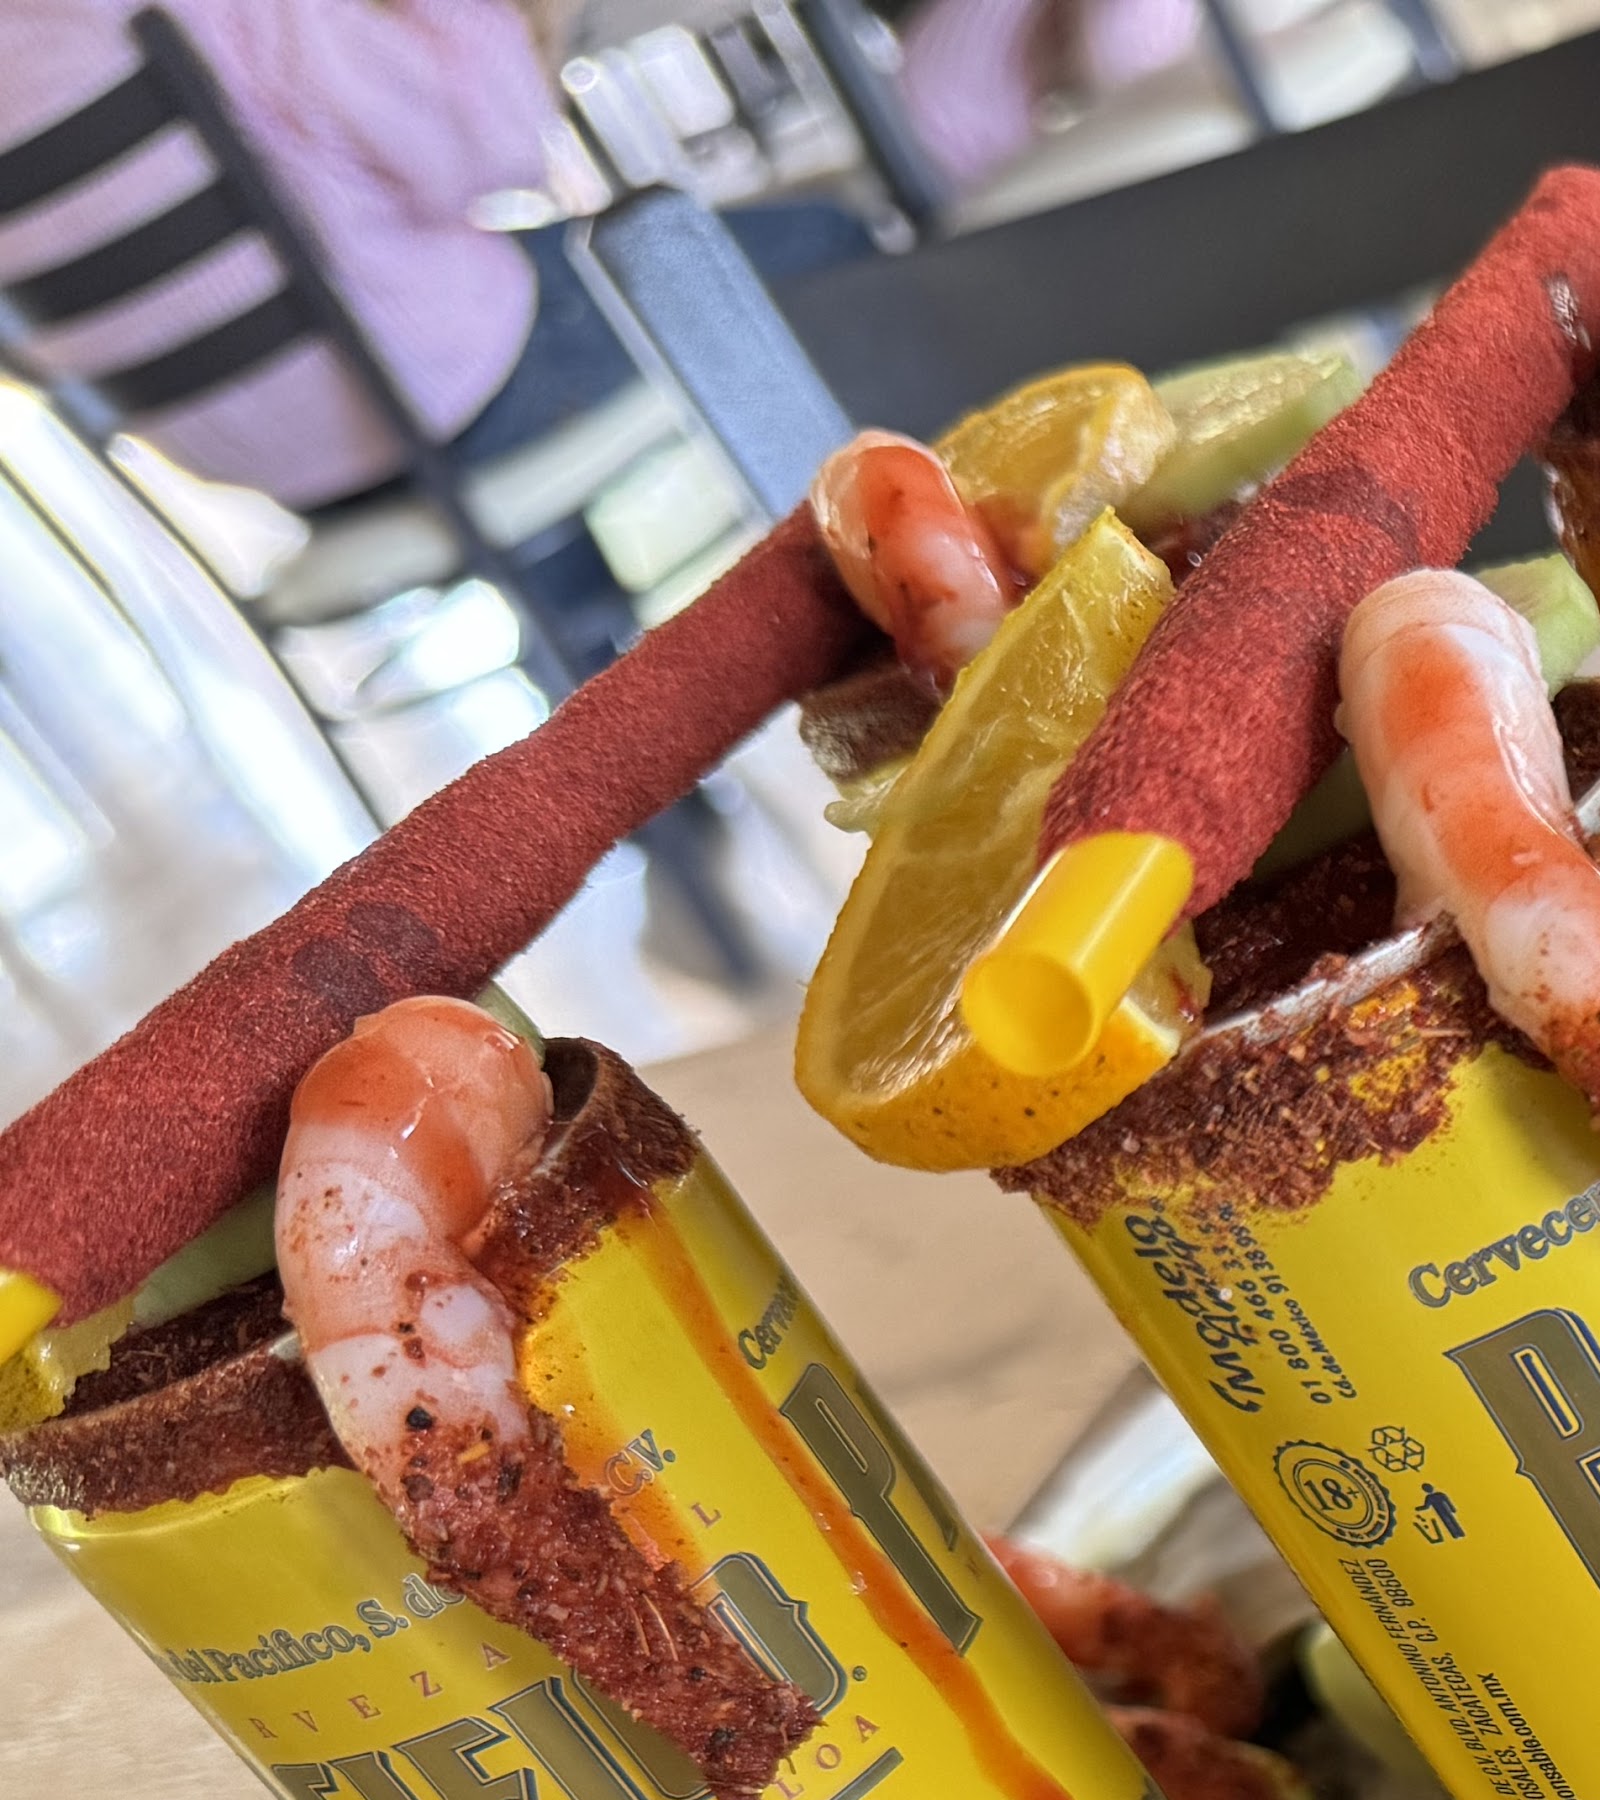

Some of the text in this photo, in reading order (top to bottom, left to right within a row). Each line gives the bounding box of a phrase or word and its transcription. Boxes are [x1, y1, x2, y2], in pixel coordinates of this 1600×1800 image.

[1124, 1213, 1266, 1413] Modelo
[1233, 1276, 1276, 1319] 466
[1282, 1298, 1329, 1356] México
[1266, 1325, 1311, 1374] 800
[1299, 1379, 1333, 1404] 01
[605, 1428, 677, 1495] C.V.
[1337, 1556, 1411, 1640] FERNÁNDEZ
[204, 1624, 372, 1683] Pacífico,
[356, 1598, 411, 1640] S.
[1407, 1614, 1440, 1645] C.P.
[249, 1641, 512, 1740] RVEZA
[1395, 1638, 1461, 1712] ANTONINO
[1431, 1650, 1504, 1739] ZACATECAS,
[1447, 1712, 1485, 1751] BLVD.
[1490, 1776, 1518, 1799] DE
